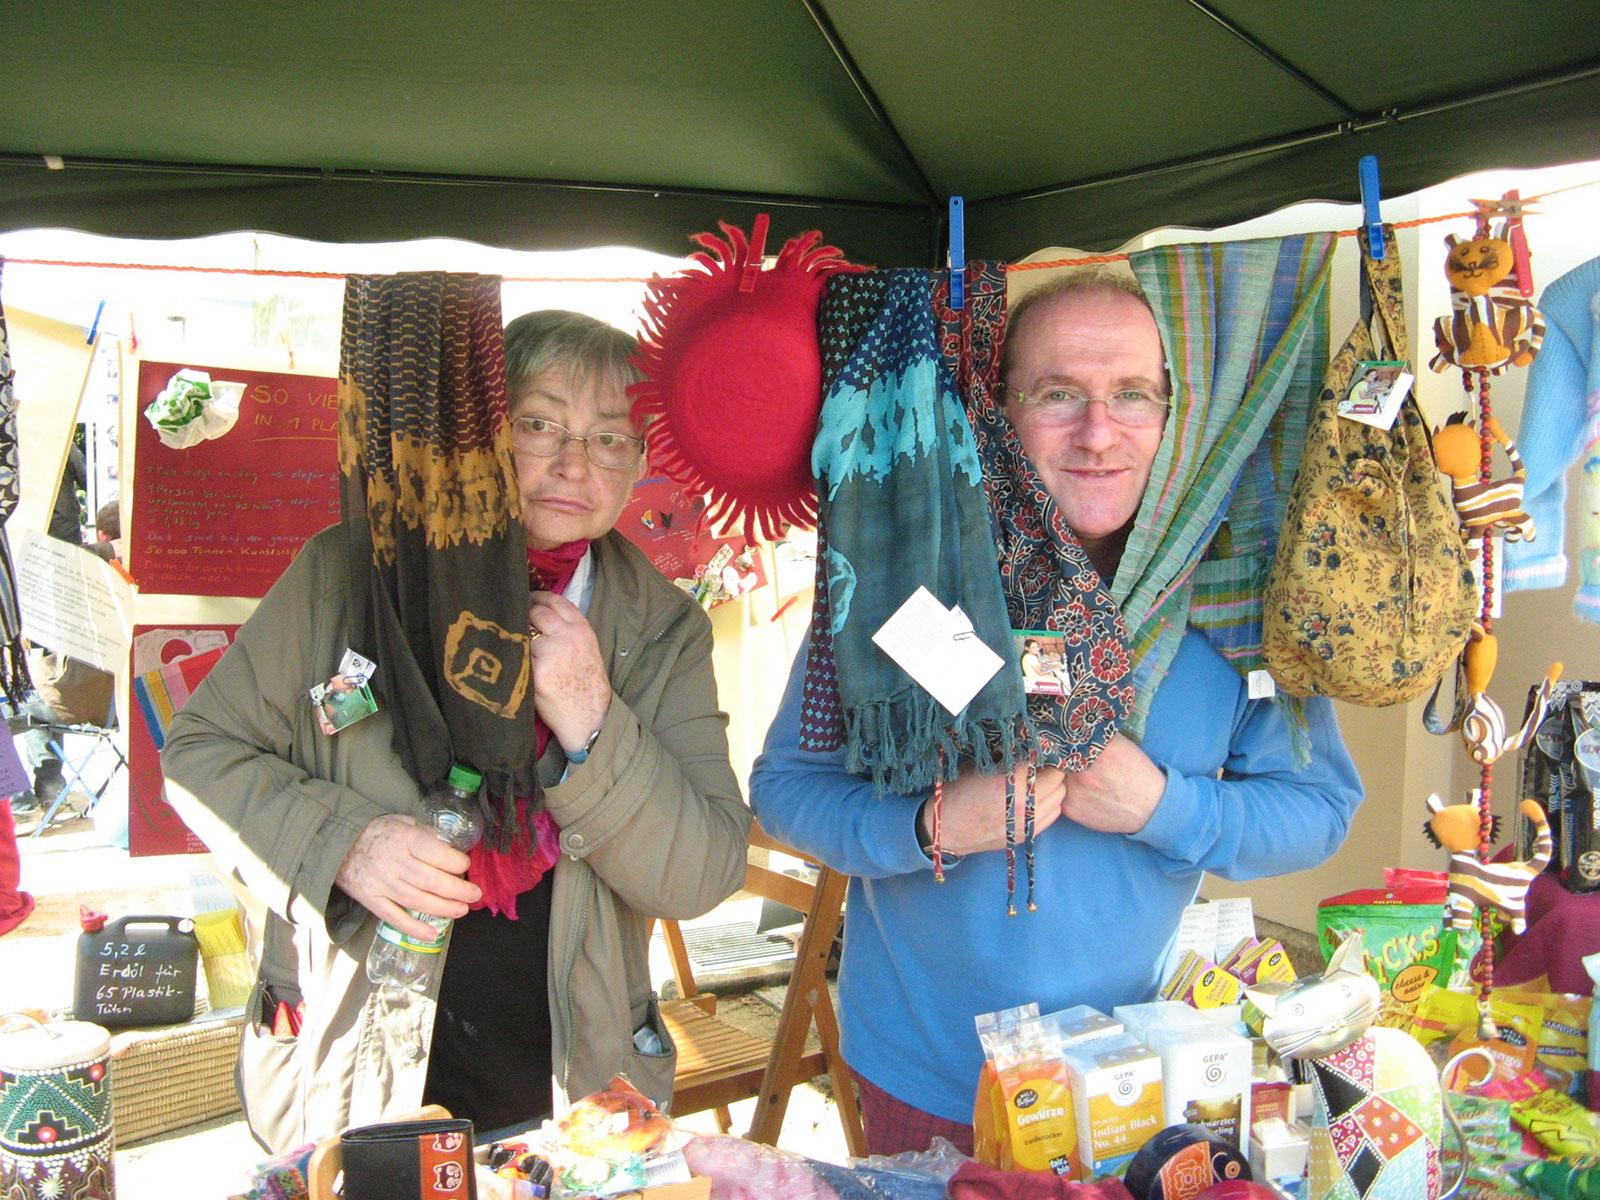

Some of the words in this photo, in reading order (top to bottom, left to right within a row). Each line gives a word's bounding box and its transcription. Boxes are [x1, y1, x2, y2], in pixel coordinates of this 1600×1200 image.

[249, 384, 289, 405] SO
[254, 413, 273, 426] IN
[100, 942, 129, 959] 5,2
[99, 962, 144, 978] Erdöl
[155, 963, 182, 984] für
[1394, 973, 1422, 991] cheese
[96, 984, 118, 1000] 65
[96, 1003, 132, 1014] Tüten
[1202, 1053, 1225, 1063] GEPA
[1114, 1070, 1134, 1081] GEPA
[1017, 1107, 1065, 1127] Gewürze
[1193, 1117, 1237, 1128] hwarztee
[1093, 1124, 1127, 1139] Indian
[1130, 1114, 1158, 1130] Black
[1094, 1139, 1112, 1149] No.
[1057, 1164, 1071, 1175] bio
